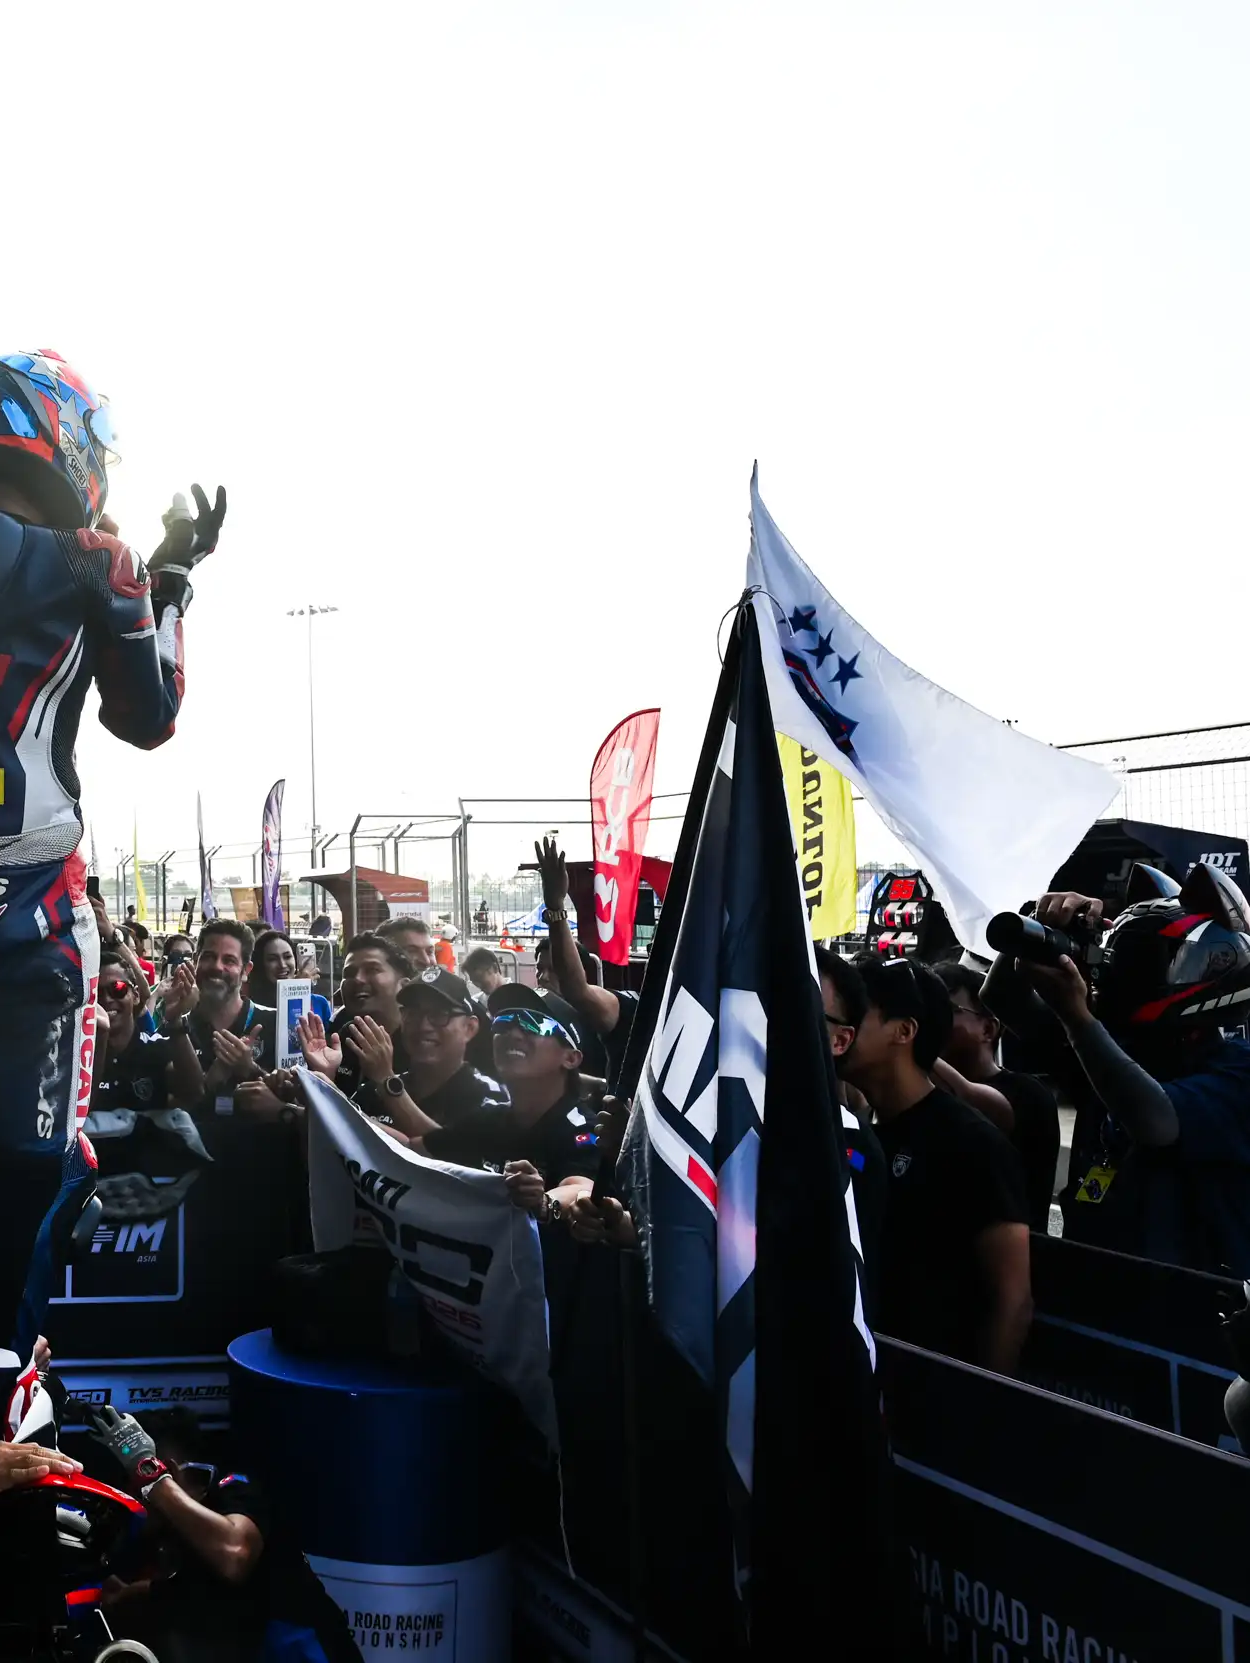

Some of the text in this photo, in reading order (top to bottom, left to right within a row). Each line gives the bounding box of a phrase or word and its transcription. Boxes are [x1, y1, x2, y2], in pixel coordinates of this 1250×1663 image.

[68, 457, 87, 486] SHOEI
[1188, 852, 1241, 868] JDT
[90, 1218, 168, 1253] FIM
[136, 1255, 158, 1264] ASIA
[128, 1385, 233, 1399] TVS RACING
[953, 1567, 1030, 1648] ROAD
[353, 1614, 391, 1631] ROAD
[396, 1611, 444, 1632] RACING
